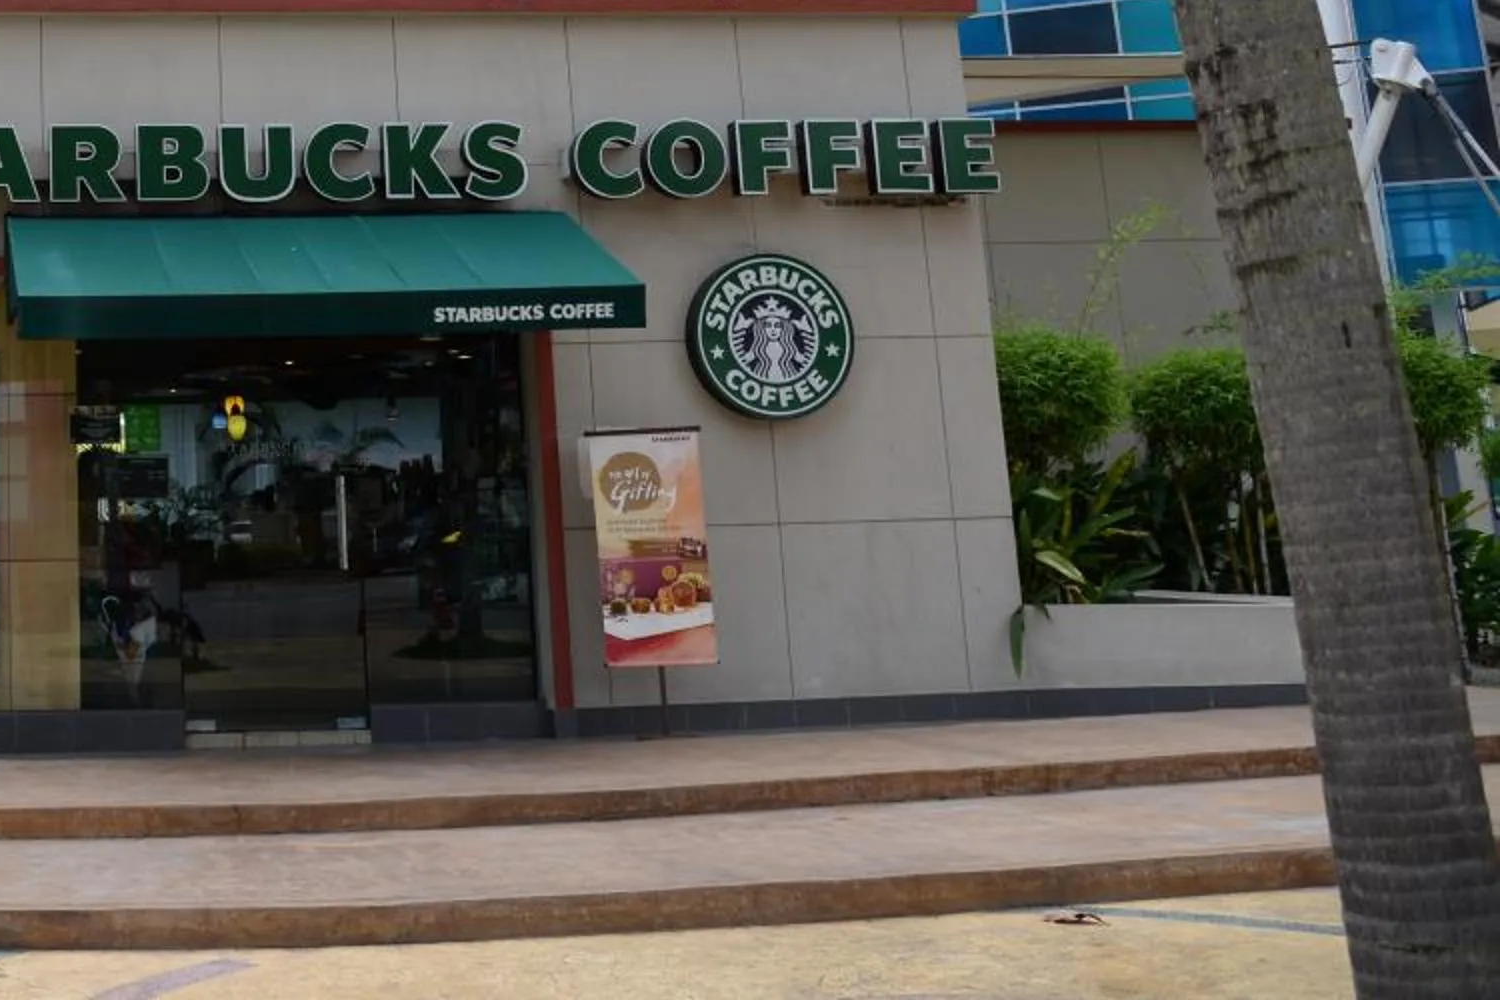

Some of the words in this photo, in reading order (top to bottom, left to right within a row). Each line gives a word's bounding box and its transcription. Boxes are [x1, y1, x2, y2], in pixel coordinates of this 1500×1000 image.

[570, 118, 1002, 199] COFFEE
[433, 304, 544, 323] STARBUCKS
[549, 301, 615, 320] COFFEE
[704, 263, 841, 333] STARBUCKS
[723, 366, 830, 408] COFFEE
